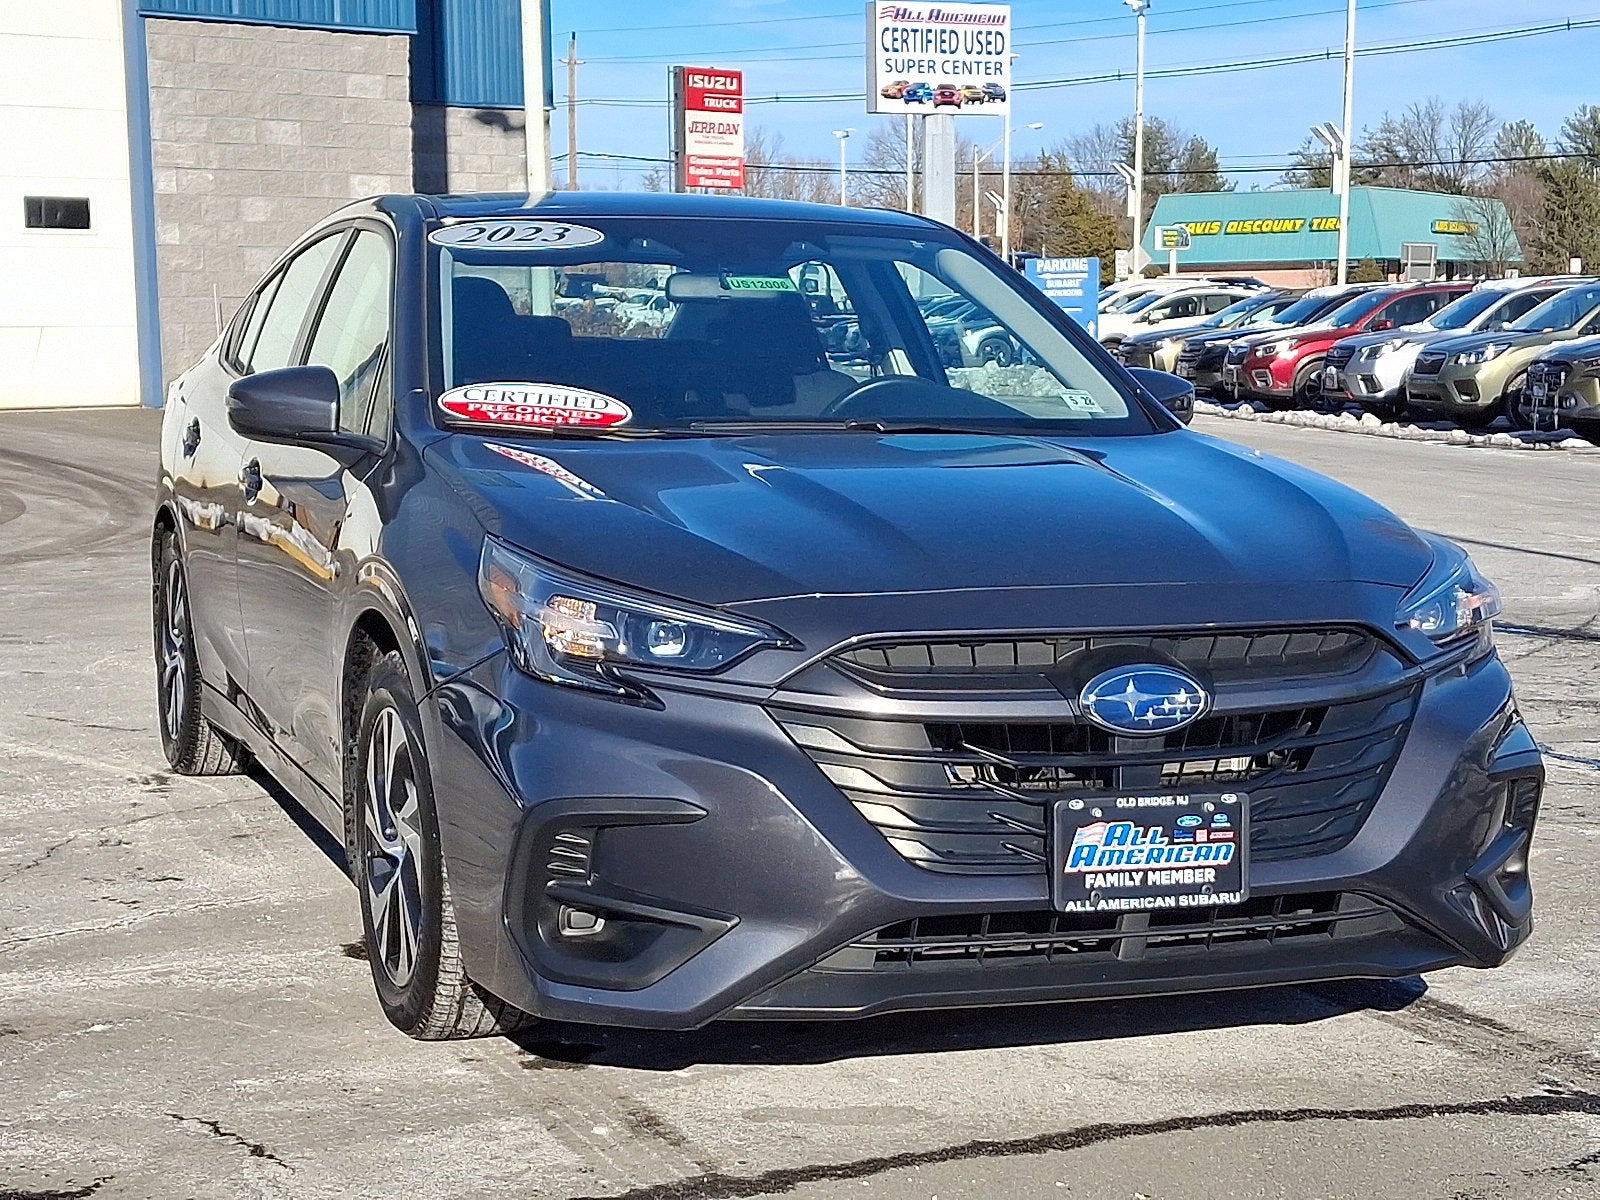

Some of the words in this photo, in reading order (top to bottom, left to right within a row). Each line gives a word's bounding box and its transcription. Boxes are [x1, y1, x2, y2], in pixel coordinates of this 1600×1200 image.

[881, 27, 959, 54] CERTIFIED
[964, 29, 1005, 55] USED
[885, 58, 936, 74] SUPER
[941, 60, 1003, 75] CENTER
[688, 74, 737, 90] ISUZU
[703, 97, 737, 109] TRUCK
[455, 225, 571, 243] 2023
[1225, 218, 1305, 234] DISCOUNT
[1036, 257, 1089, 272] PARKING
[730, 280, 789, 289] US12006
[463, 388, 609, 410] CERTIFIED
[466, 402, 603, 420] PRE-OWNED
[486, 411, 581, 425] VEHICLE
[1116, 798, 1136, 808] OLD
[1177, 795, 1189, 806] NJ
[1103, 823, 1168, 847] ALL
[1069, 844, 1233, 868] AMERICAN
[1085, 871, 1145, 889] FAMILY
[1147, 867, 1216, 886] MEMBER
[1065, 900, 1095, 912] ALL
[1097, 895, 1176, 911] AMERICAN
[1179, 891, 1242, 907] SUBARU
